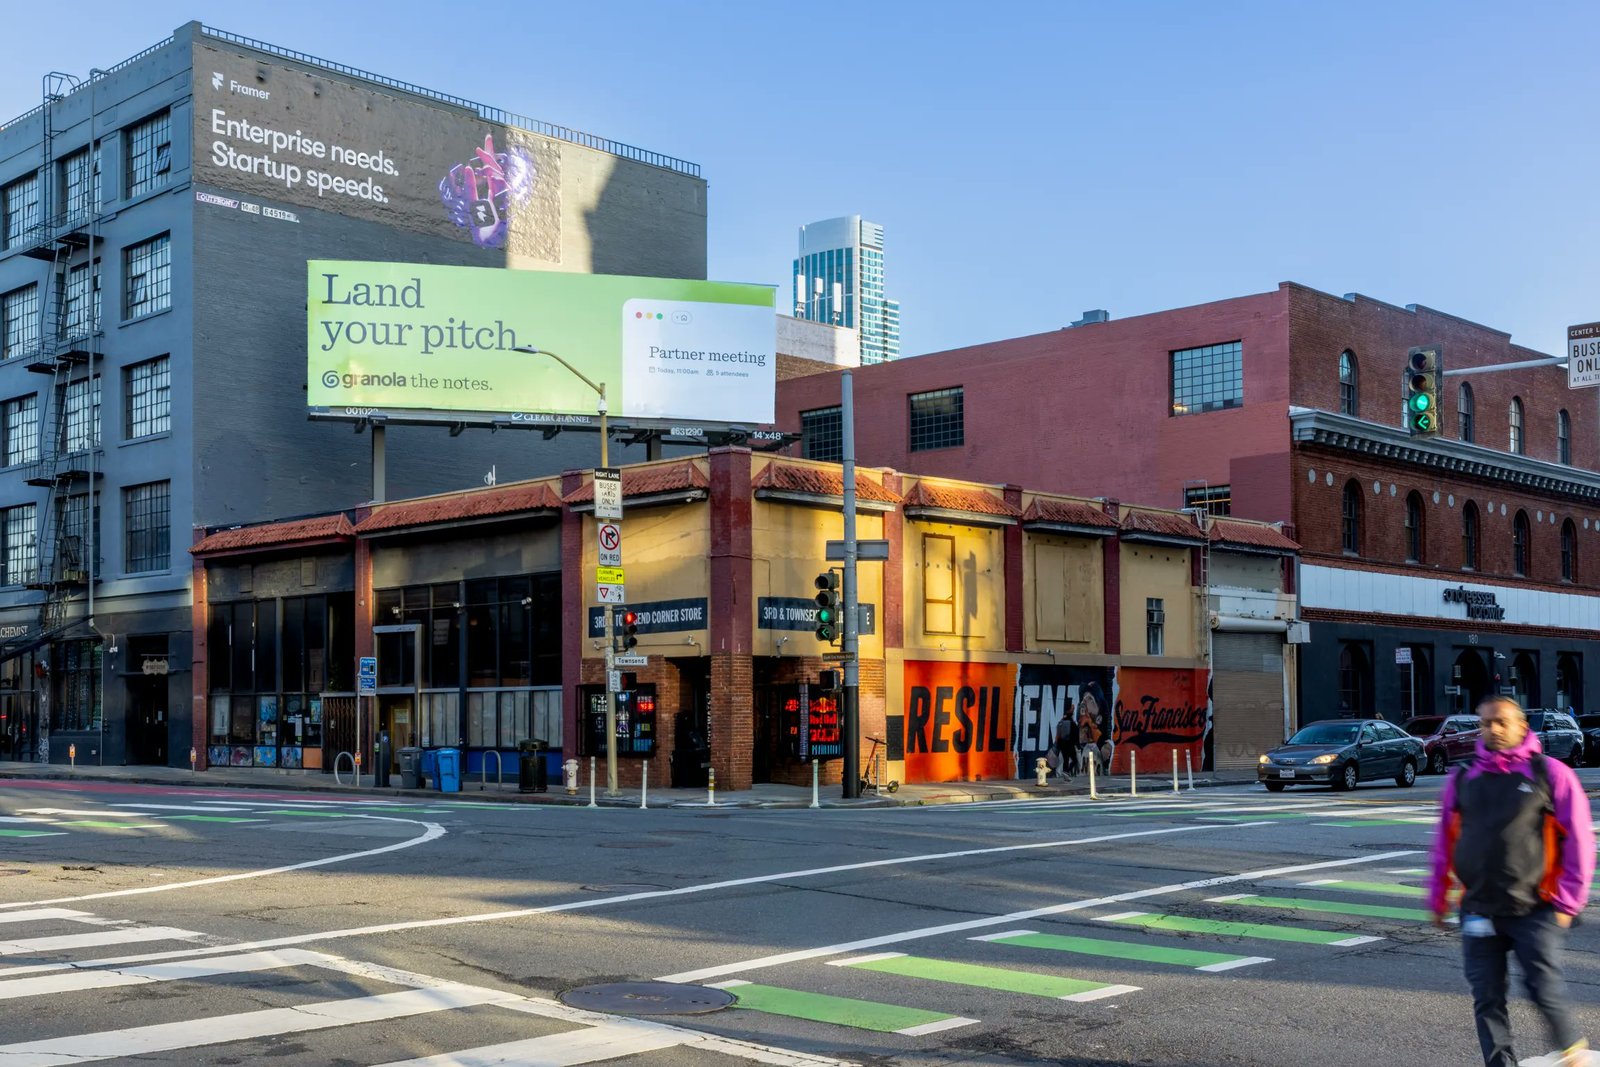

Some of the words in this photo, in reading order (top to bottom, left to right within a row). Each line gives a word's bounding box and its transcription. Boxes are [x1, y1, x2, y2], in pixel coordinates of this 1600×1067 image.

[230, 79, 271, 100] Framer
[212, 108, 326, 159] Enterprise
[331, 145, 400, 177] needs.
[212, 140, 301, 188] Startup
[306, 169, 389, 204] speeds.
[321, 273, 425, 309] Land
[320, 320, 414, 352] your
[1570, 327, 1594, 337] CENTER
[648, 345, 705, 361] Partner
[708, 351, 766, 367] meeting
[1577, 357, 1600, 373] ONL
[342, 371, 407, 389] granola
[411, 373, 439, 389] the
[443, 377, 493, 391] notes.
[599, 481, 617, 491] BUSES
[1443, 585, 1497, 605] andreessen
[652, 609, 679, 623] CORNER
[681, 607, 702, 621] STORE
[763, 606, 777, 620] 3RD
[780, 607, 785, 620] &
[786, 608, 820, 622] TOWNSEN
[1467, 603, 1506, 620] horowitz
[0, 625, 28, 638] CHEMIST
[1468, 634, 1479, 644] 180
[1111, 699, 1139, 745] San
[1137, 695, 1209, 734] Francisco
